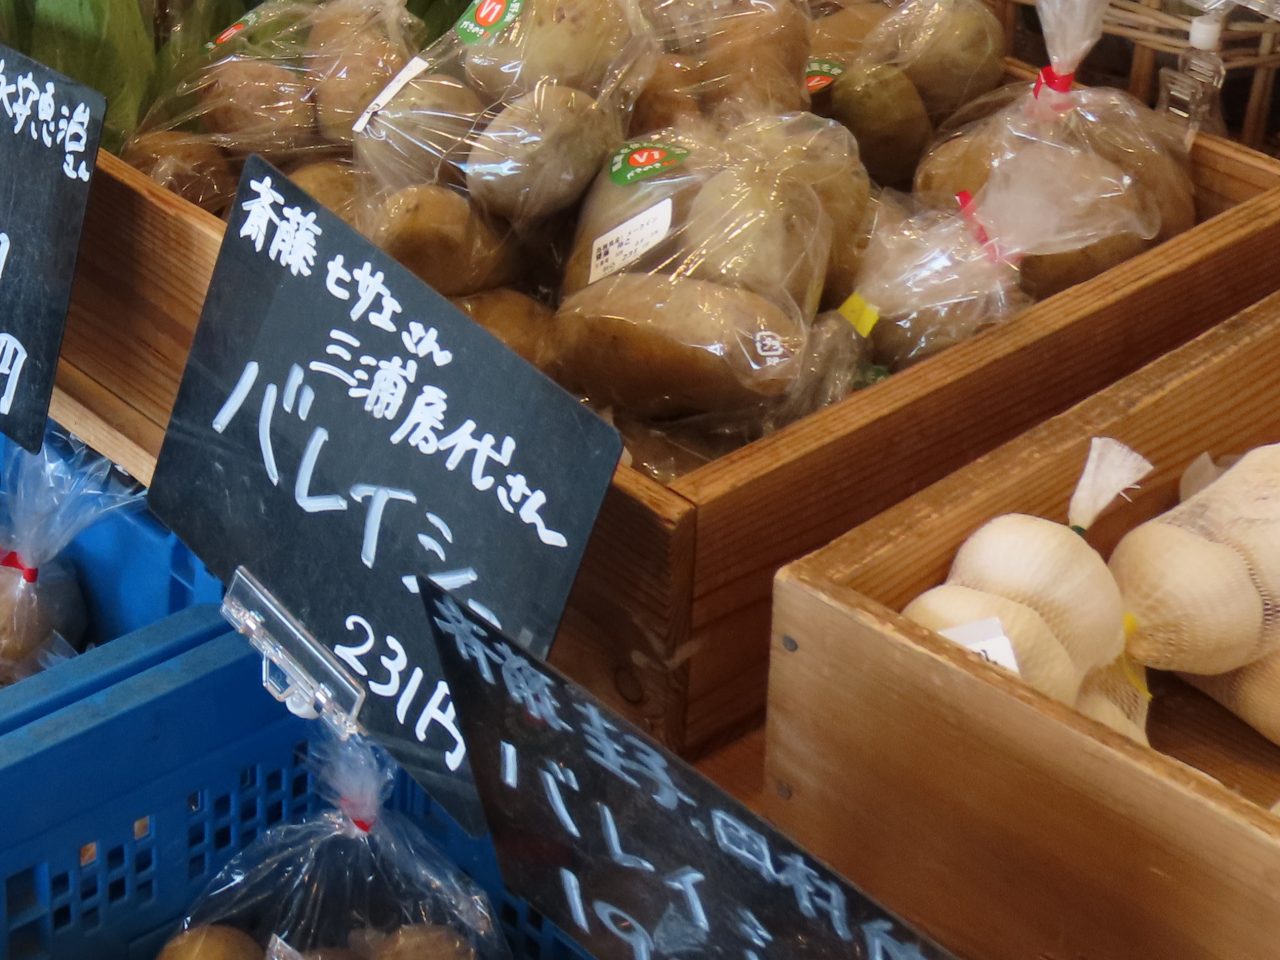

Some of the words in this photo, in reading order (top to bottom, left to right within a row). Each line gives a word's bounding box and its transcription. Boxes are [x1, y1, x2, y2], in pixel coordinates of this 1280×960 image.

[633, 149, 662, 166] V1
[212, 361, 502, 629] バレイシ
